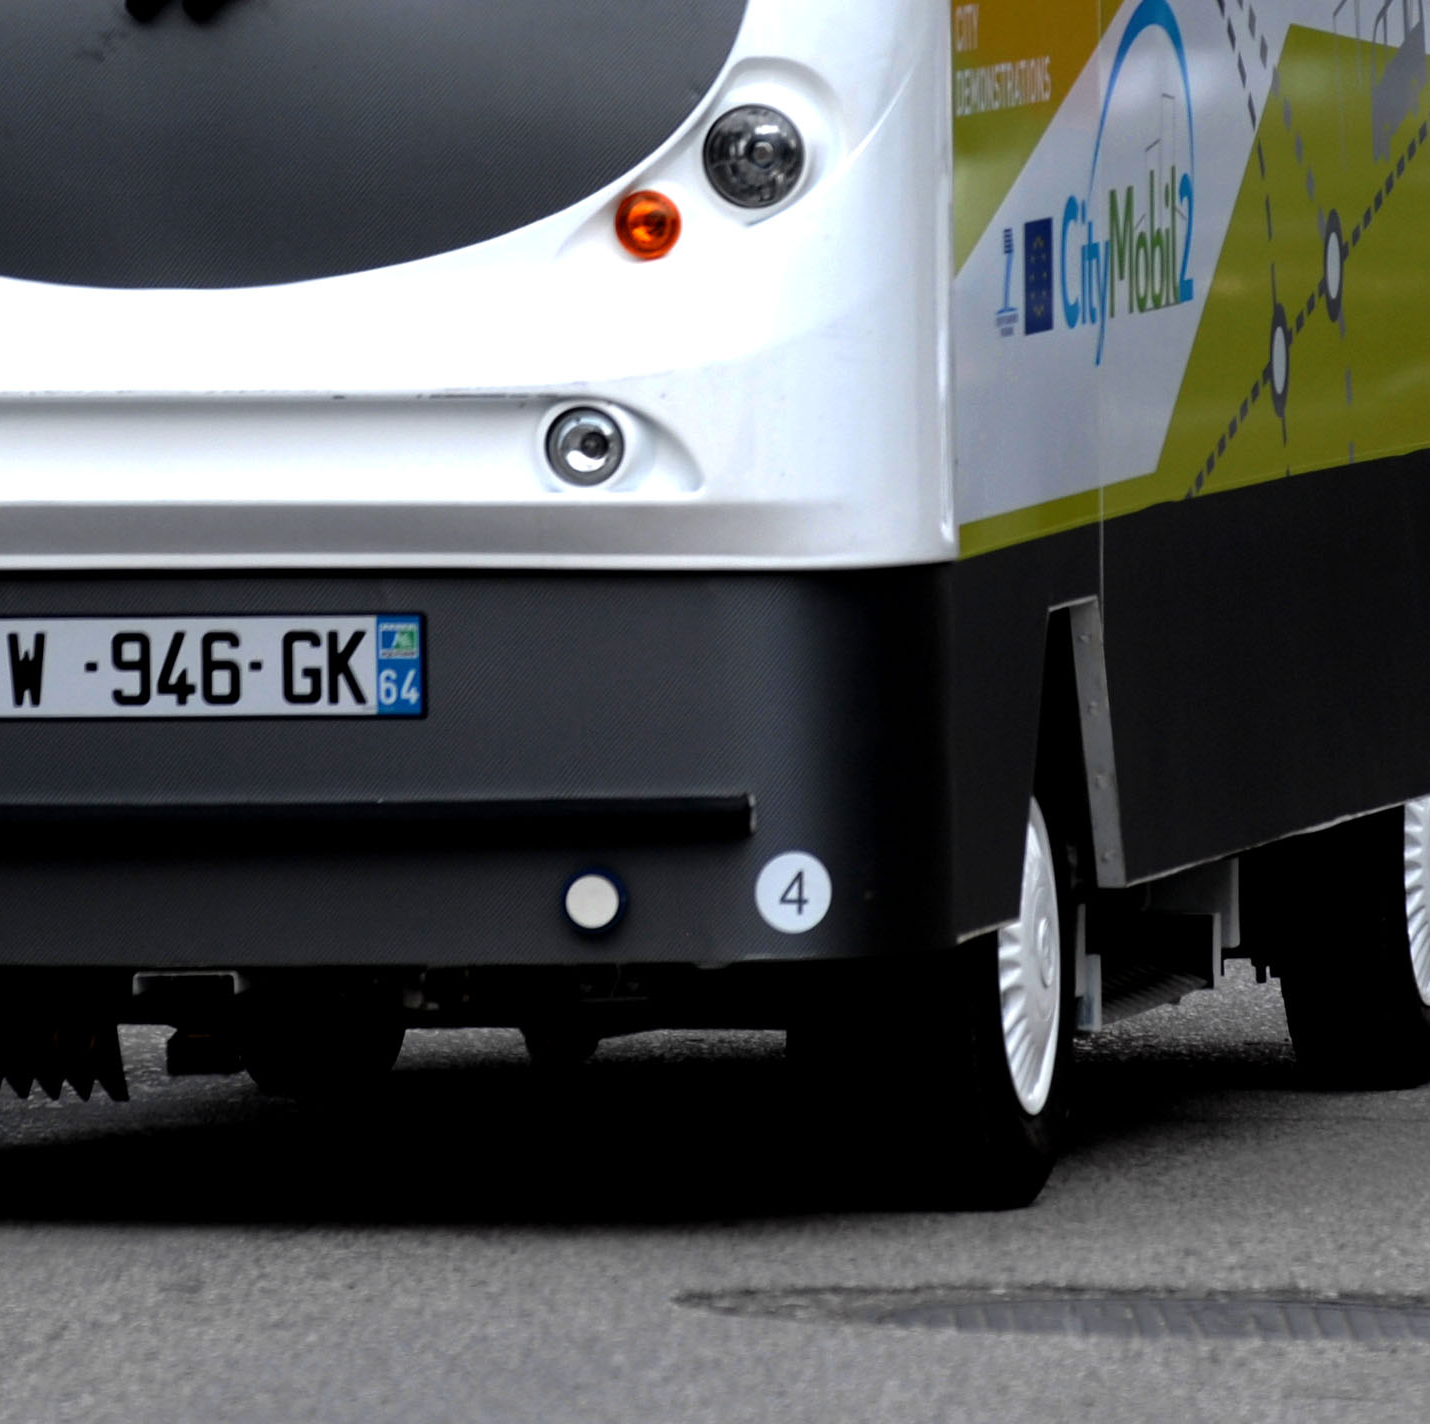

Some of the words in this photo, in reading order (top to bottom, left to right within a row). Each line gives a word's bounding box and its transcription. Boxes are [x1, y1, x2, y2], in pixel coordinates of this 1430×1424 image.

[955, 3, 979, 52] CITY
[955, 55, 1053, 118] DEMONSTRATIONS
[1060, 164, 1193, 367] CityMobil2
[379, 667, 420, 705] 64
[779, 868, 809, 915] 4
